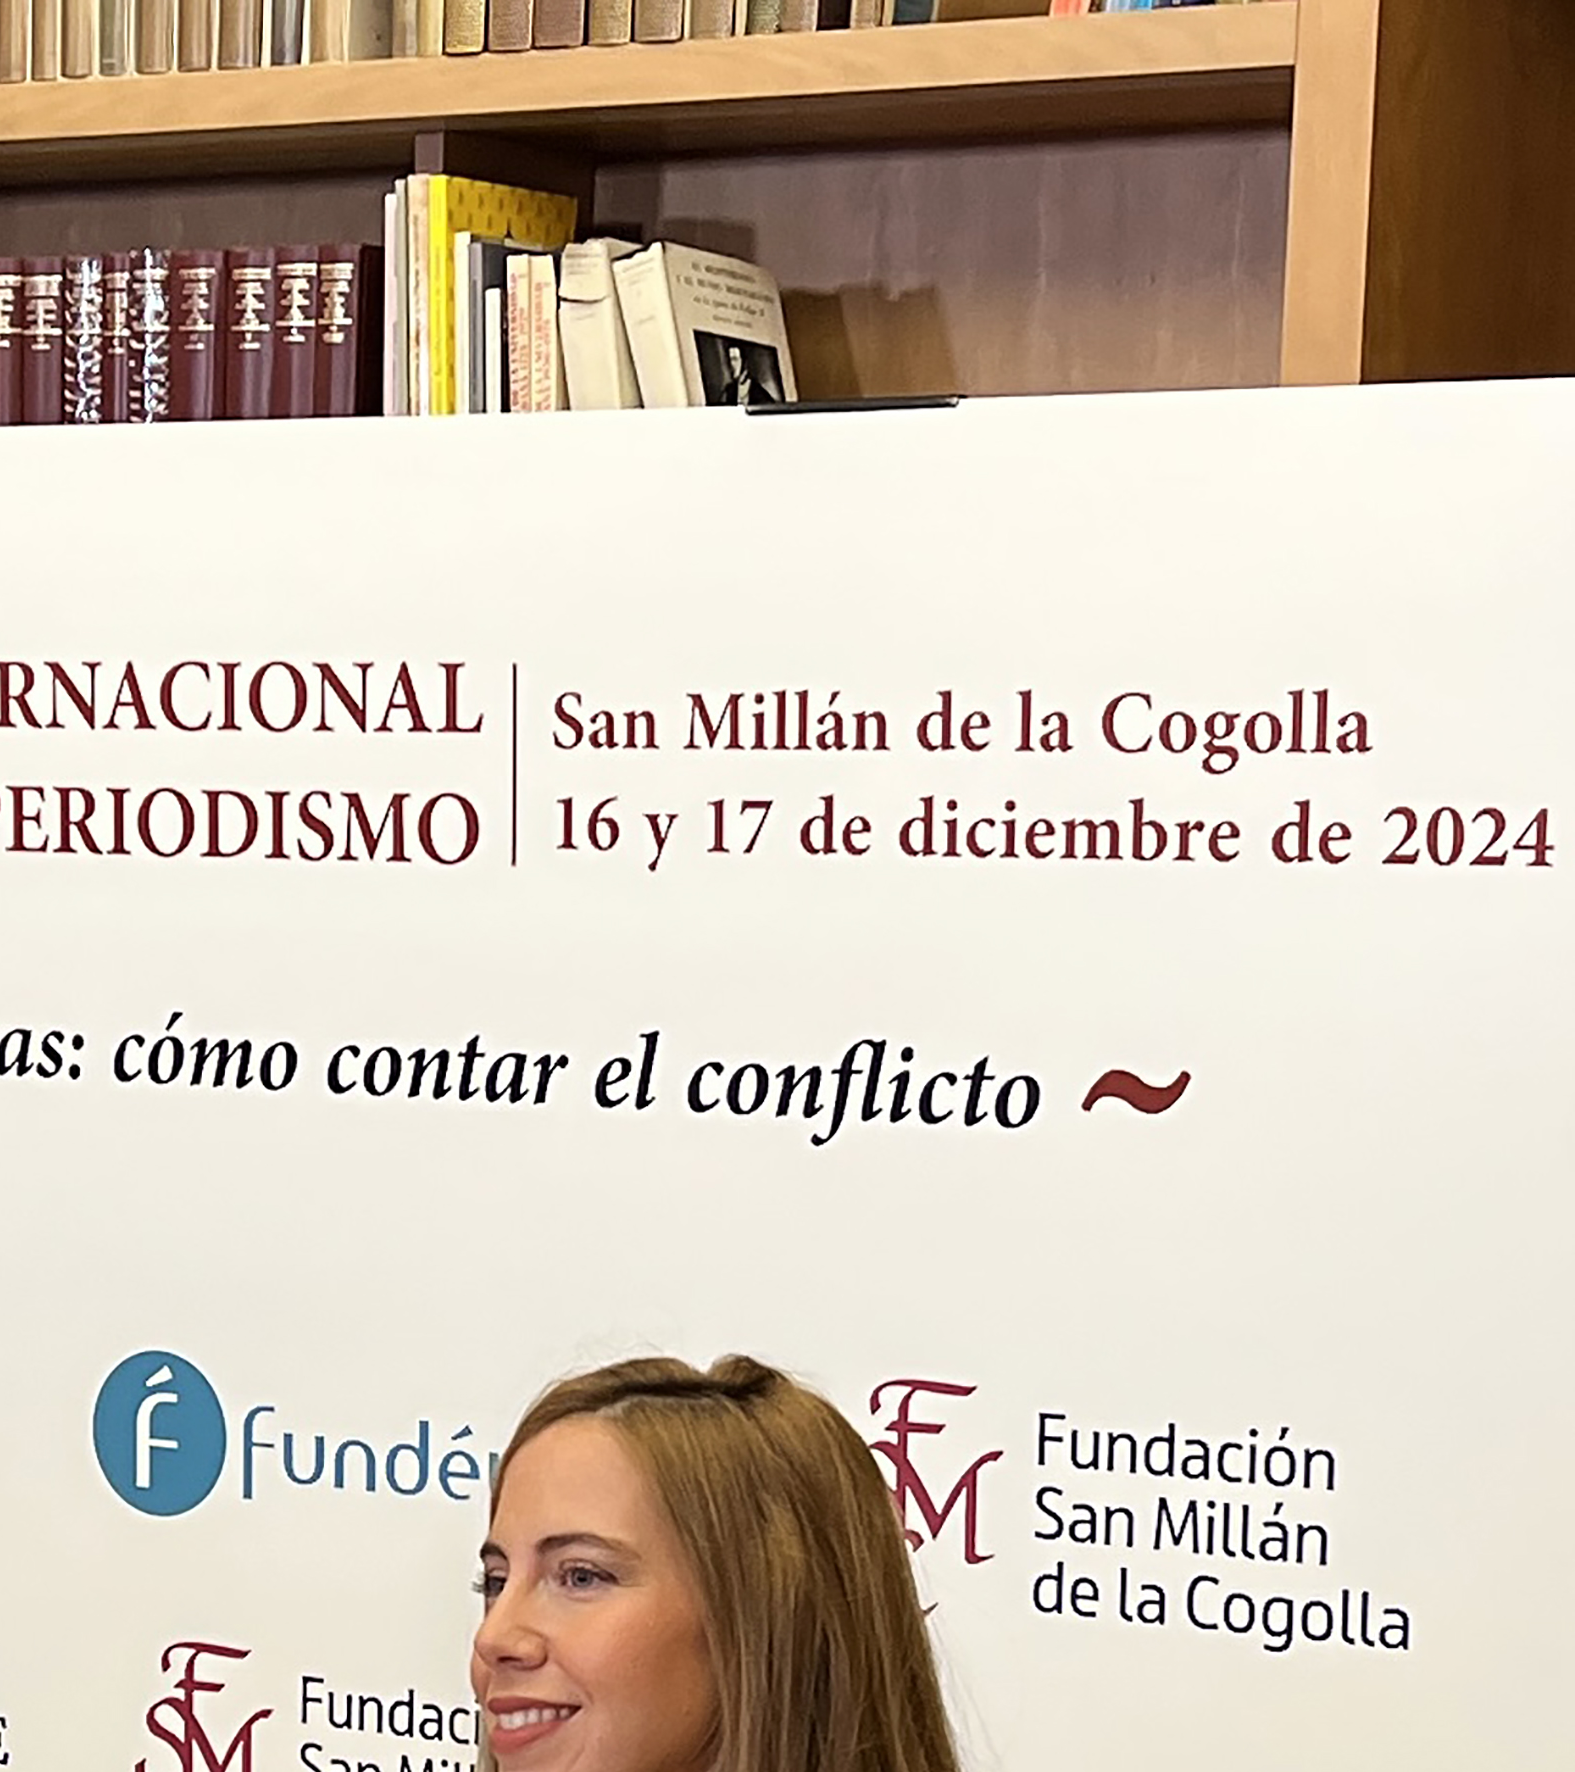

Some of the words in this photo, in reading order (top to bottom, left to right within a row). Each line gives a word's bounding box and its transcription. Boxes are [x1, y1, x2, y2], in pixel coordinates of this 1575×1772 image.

[553, 692, 659, 749] San
[684, 690, 890, 751] Millán
[917, 690, 990, 751] de
[1015, 690, 1073, 752] la
[1102, 689, 1372, 774] Cogolla
[557, 797, 619, 851] 16
[644, 814, 678, 872] y
[707, 799, 773, 853] 17
[800, 795, 871, 855] de
[899, 795, 1240, 862] diciembre
[1272, 800, 1351, 864] de
[1382, 807, 1554, 866] 2024
[114, 1012, 297, 1091] cómo
[328, 1035, 568, 1104] contar
[595, 1031, 659, 1110] el
[688, 1039, 1040, 1146] conflicto
[243, 1406, 499, 1500] fundé
[1038, 1413, 1334, 1490] Fundación
[1035, 1487, 1133, 1547] San
[1153, 1497, 1327, 1565] Millán
[1033, 1561, 1099, 1617] de
[1120, 1568, 1165, 1625] la
[1187, 1575, 1409, 1652] Cogolla
[300, 1676, 480, 1746] Fundaci
